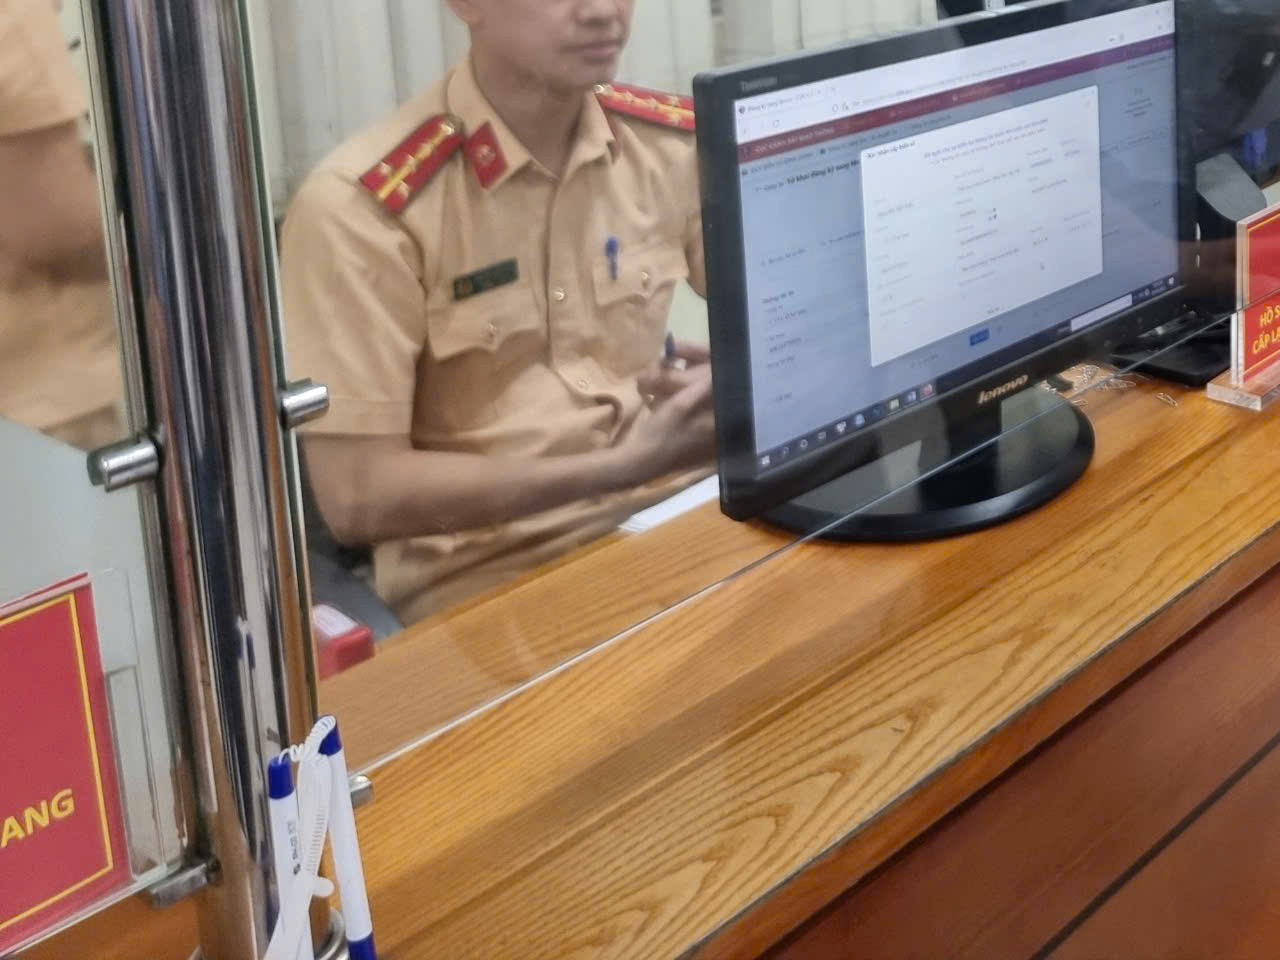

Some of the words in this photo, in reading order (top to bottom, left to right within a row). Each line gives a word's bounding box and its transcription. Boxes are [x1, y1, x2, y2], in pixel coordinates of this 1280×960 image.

[1260, 305, 1274, 328] HỒ
[1252, 331, 1271, 354] CẤP
[978, 374, 1029, 404] lenovo
